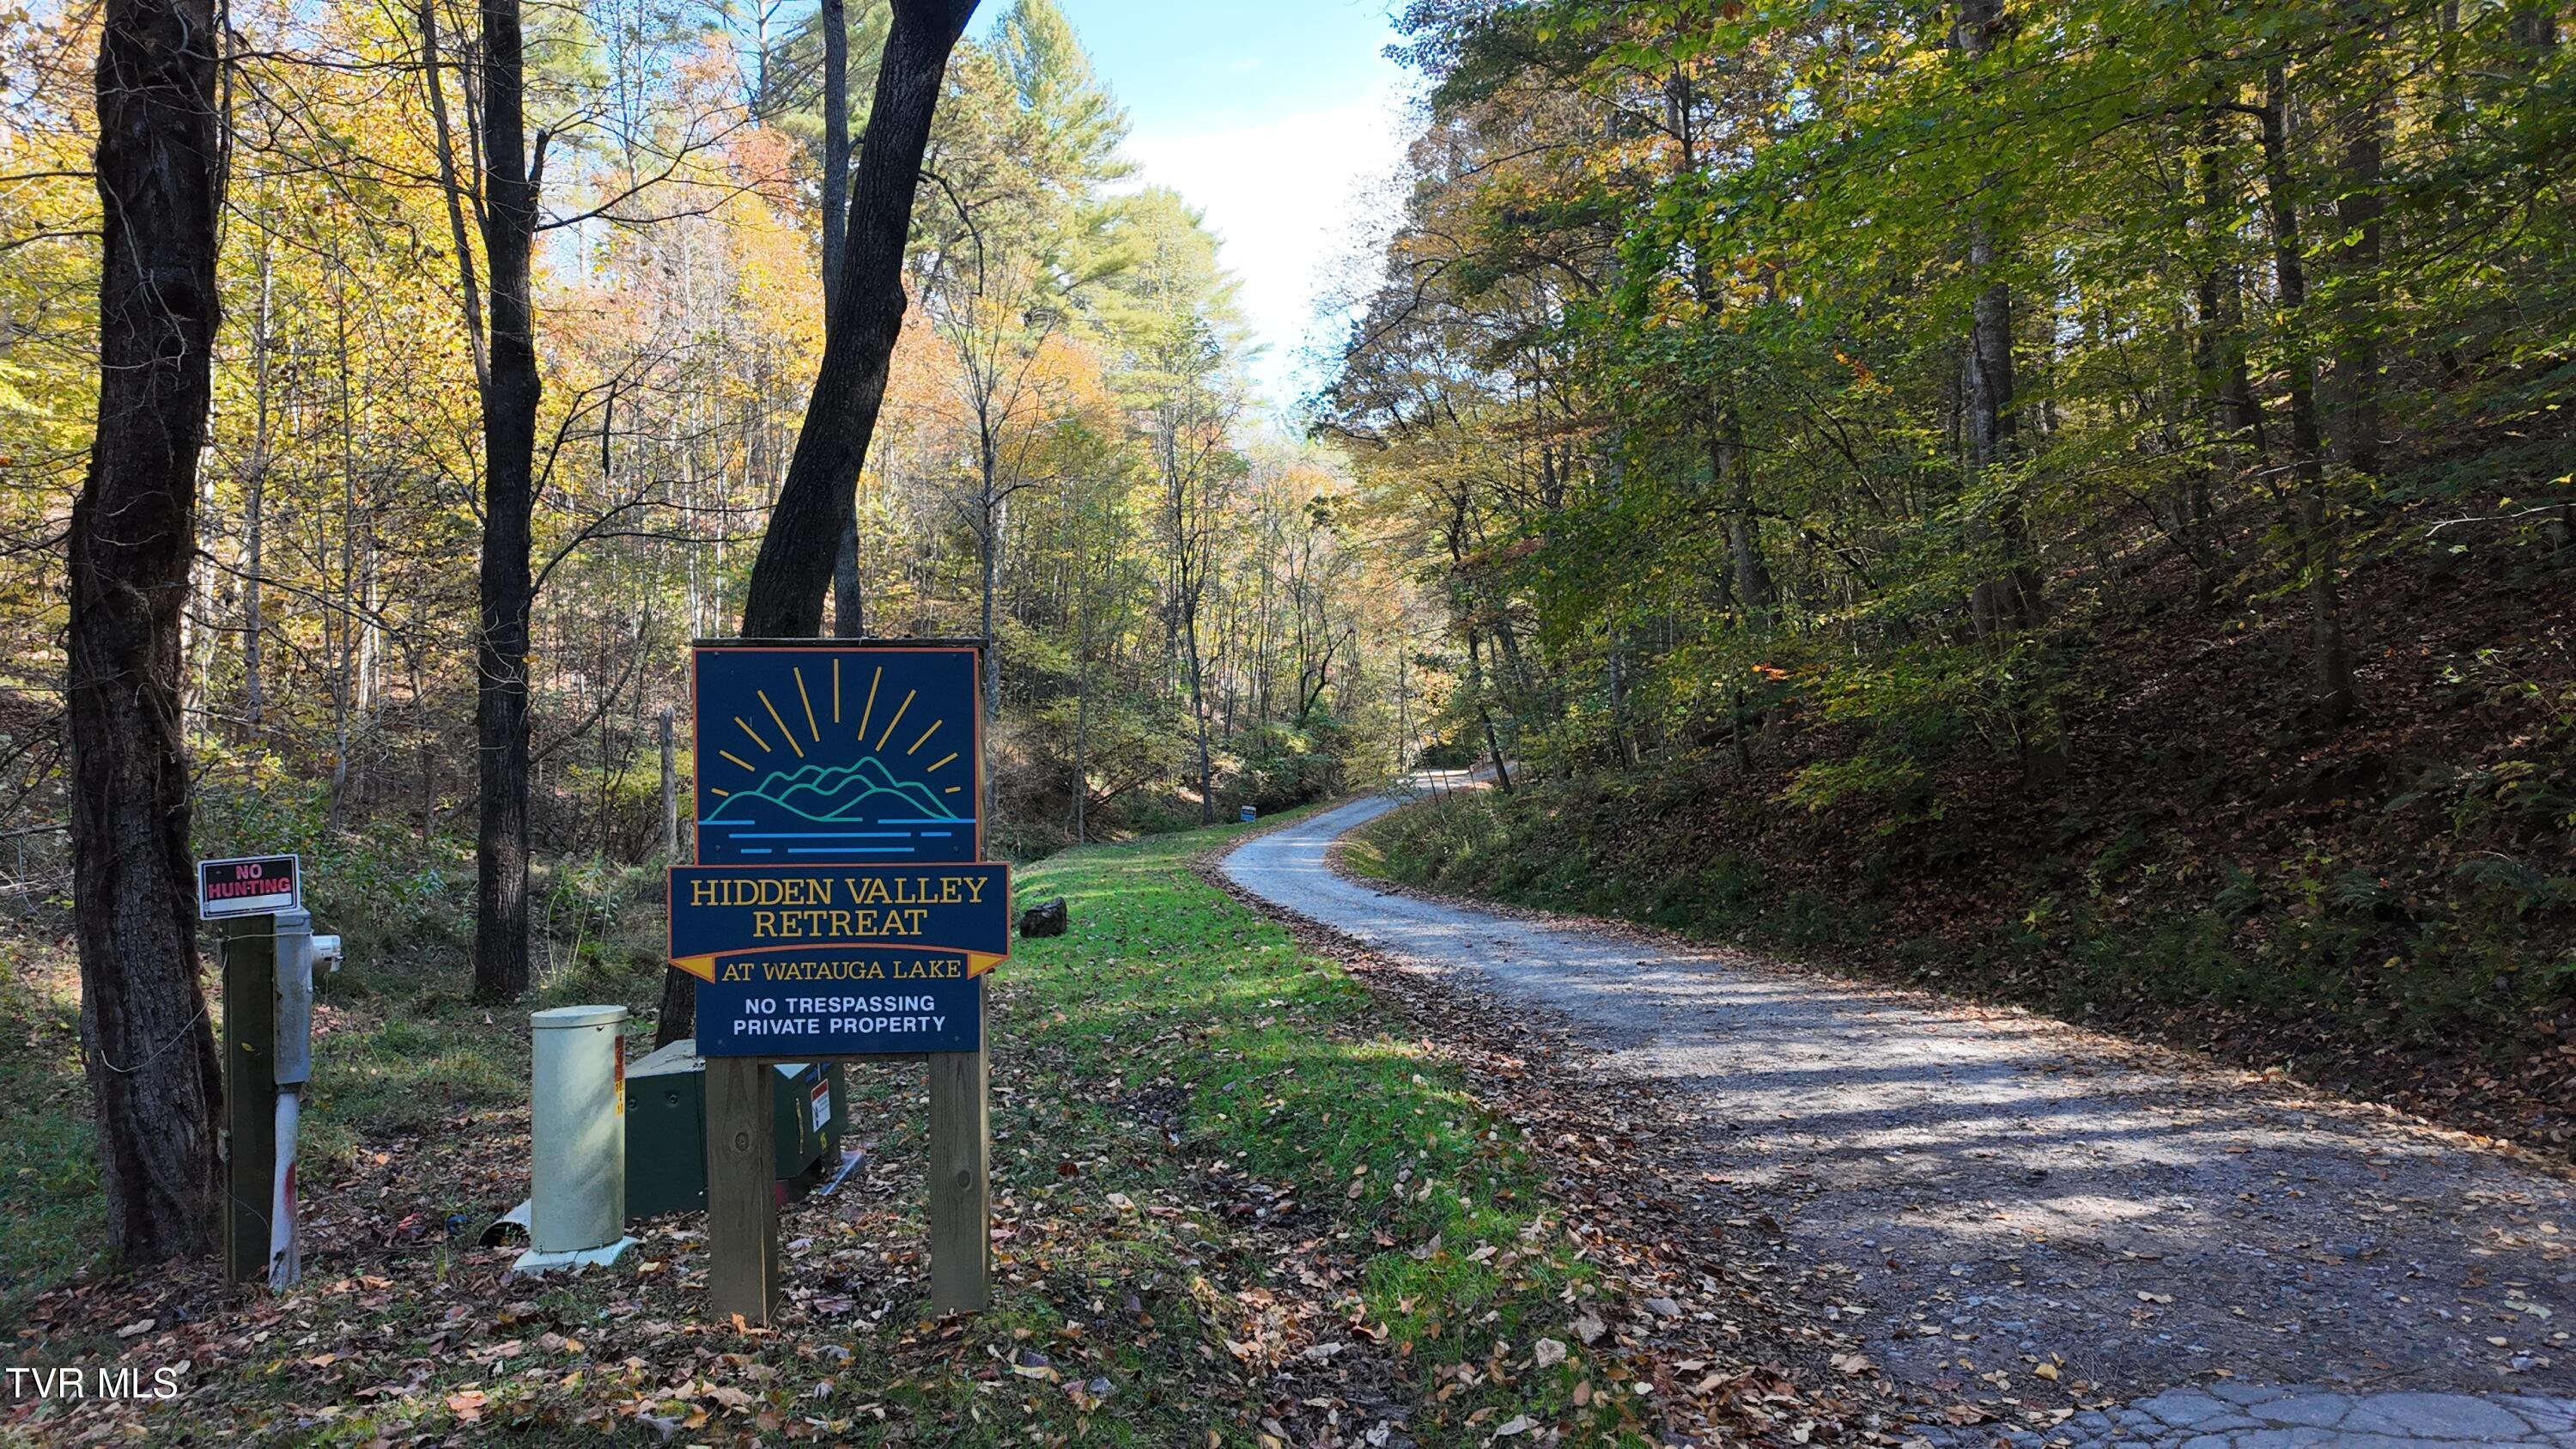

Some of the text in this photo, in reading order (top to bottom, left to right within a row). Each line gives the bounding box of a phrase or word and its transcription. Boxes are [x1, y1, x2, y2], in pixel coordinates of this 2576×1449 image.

[235, 863, 263, 880] NO
[208, 877, 292, 898] HUNTING
[690, 876, 988, 906] HIDDEN VALLEY
[752, 909, 928, 938] RETREAT
[721, 959, 962, 982] AT WATAUGA LAKE
[745, 995, 935, 1015] NO TRESPASSING
[733, 1015, 946, 1036] PRIVATE PROPERTY
